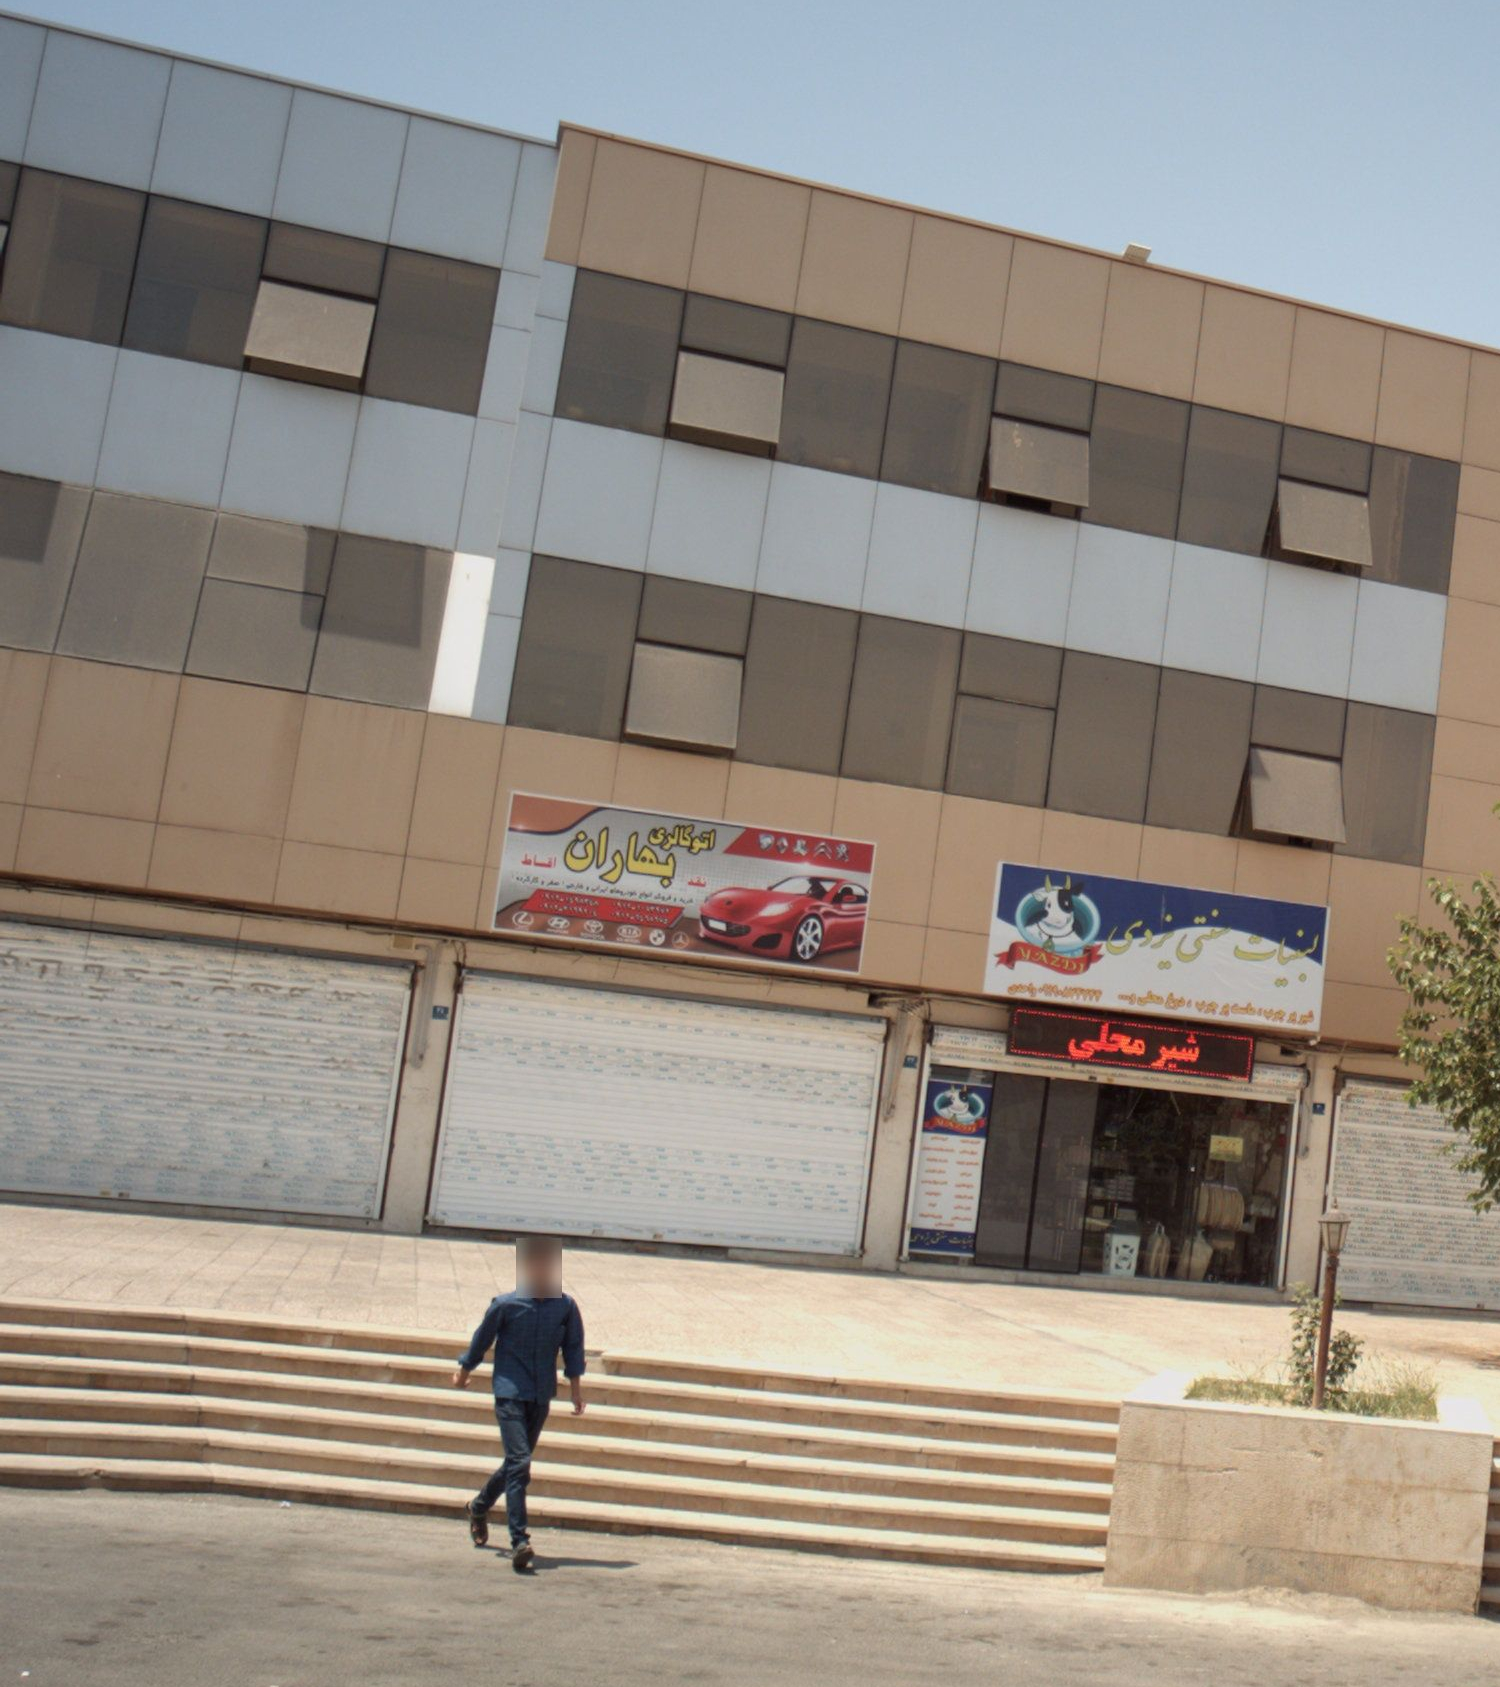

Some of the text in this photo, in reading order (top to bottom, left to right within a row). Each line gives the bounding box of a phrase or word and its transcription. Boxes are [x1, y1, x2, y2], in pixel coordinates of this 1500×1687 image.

[563, 826, 676, 888] بهاران
[648, 824, 716, 855] اتوگالری
[521, 854, 557, 868] اقساط
[687, 875, 707, 888] نقد
[1106, 909, 1319, 987] لبنیات سنتی یزدی
[1068, 1022, 1200, 1070] شیر محلی
